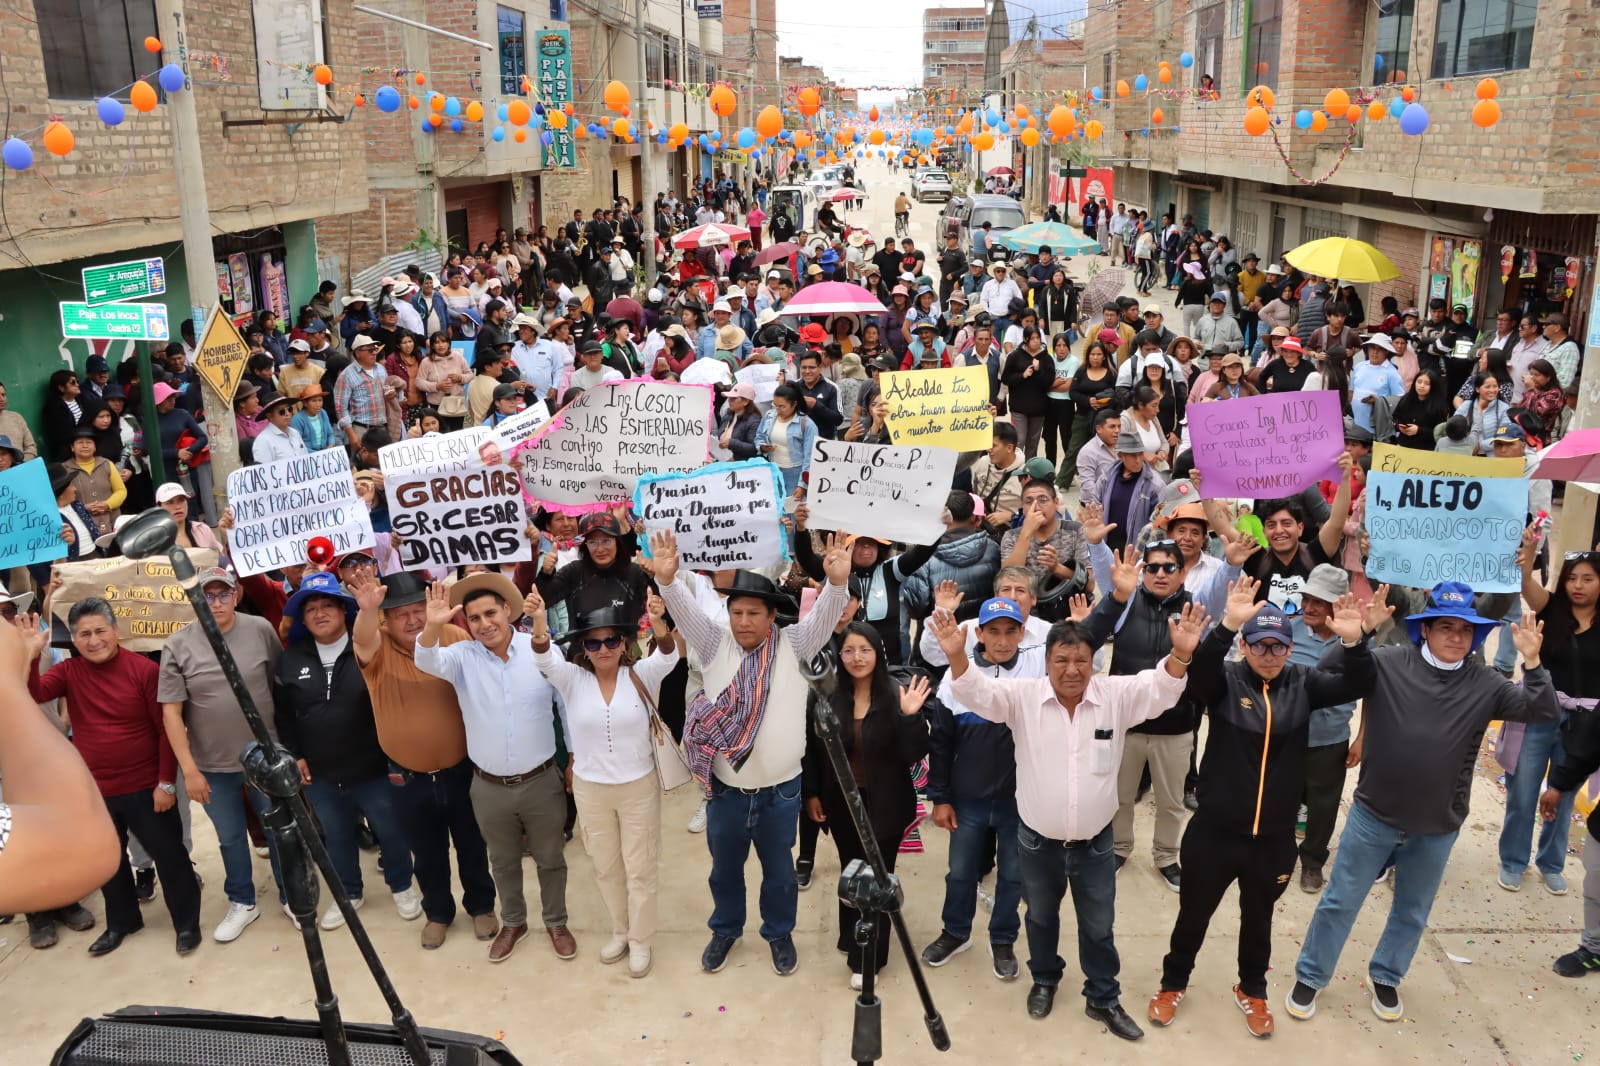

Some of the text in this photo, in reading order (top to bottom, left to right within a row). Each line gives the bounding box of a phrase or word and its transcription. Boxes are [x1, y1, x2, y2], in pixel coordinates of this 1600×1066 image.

[556, 59, 570, 166] PASTERIA
[107, 272, 117, 282] Jr.
[101, 310, 115, 320] Los
[107, 323, 130, 333] Cuadra
[203, 342, 241, 359] HOMBRES
[203, 351, 243, 368] TRABAJANDO
[634, 383, 687, 414] Cesar
[886, 374, 972, 400] Alcalde tus
[500, 417, 542, 438] ING. CESAR
[585, 413, 608, 434] LAS
[619, 417, 704, 437] ESMERALDAS
[893, 430, 900, 440] a
[949, 415, 989, 432] distrito
[1204, 399, 1318, 435] Gracias Ing ALEJO
[561, 434, 603, 458] contigo
[618, 437, 682, 457] presente.
[1200, 441, 1217, 457] por
[1275, 426, 1288, 445] la
[1290, 425, 1329, 453] gestión
[383, 441, 435, 470] MUCHAS
[542, 456, 604, 473] Esmeralda
[1216, 452, 1228, 468] de
[1255, 449, 1290, 473] pistas
[1296, 446, 1309, 463] de
[228, 467, 269, 499] GRACIAS
[286, 455, 322, 486] ALCALDE
[322, 449, 349, 476] CESAR
[525, 473, 536, 486] de
[541, 474, 552, 487] tu
[600, 479, 627, 490] para
[1236, 473, 1302, 491] ROMANCOTO
[229, 496, 266, 523] DAMAS
[317, 480, 351, 504] GRAN
[645, 482, 706, 504] Grasias
[1398, 478, 1483, 511] ALEJO
[748, 498, 771, 515] por
[235, 507, 345, 549] OBRA EN BENEFICIO
[675, 515, 736, 534] la obra
[1370, 515, 1523, 541] ROMANCOTO
[27, 532, 63, 562] gesti
[243, 531, 351, 572] DE LA POION
[403, 527, 520, 567] DAMAS
[697, 530, 758, 551] Augusto
[131, 620, 191, 635] ROMANCOT
